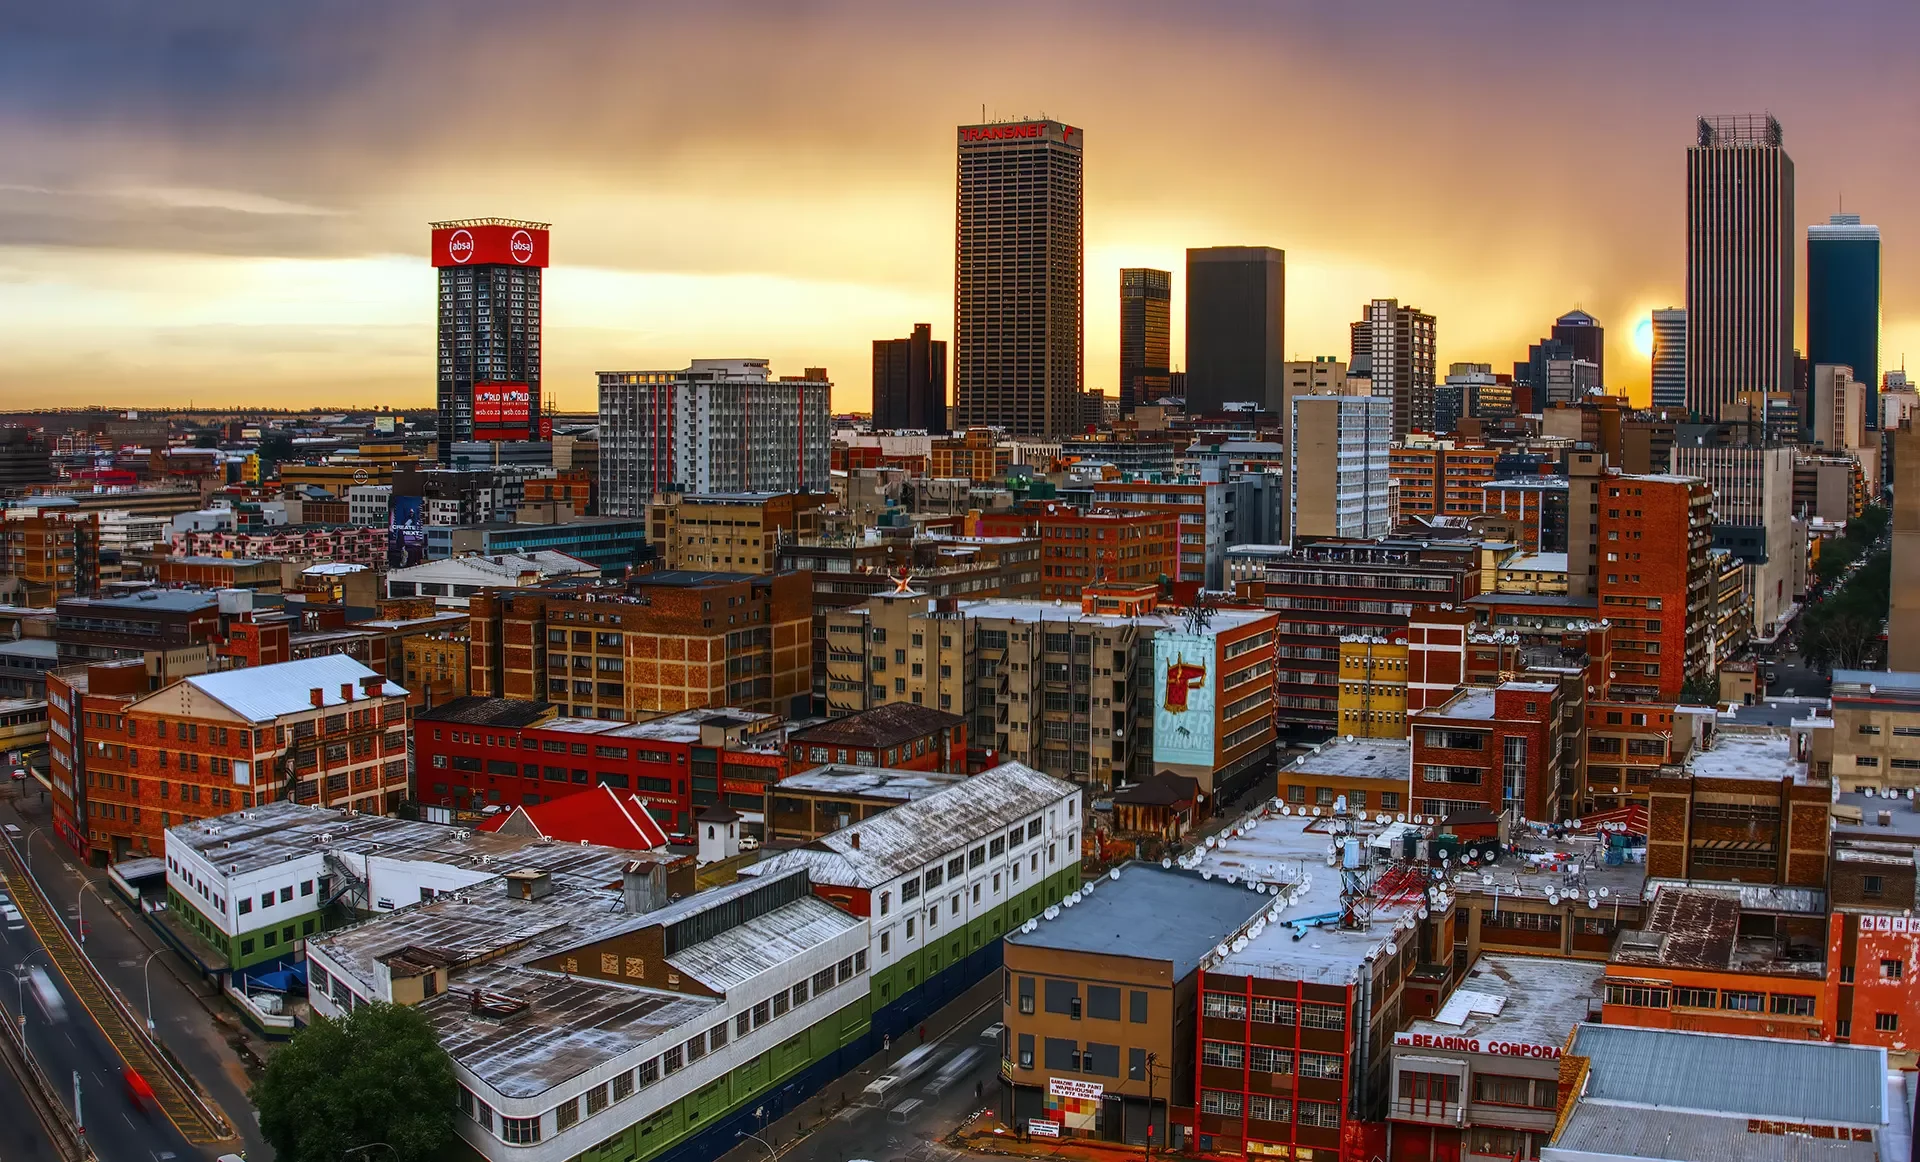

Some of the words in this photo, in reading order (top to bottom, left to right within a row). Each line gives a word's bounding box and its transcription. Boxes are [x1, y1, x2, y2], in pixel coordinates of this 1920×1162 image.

[960, 124, 1047, 142] TRANSNET
[452, 239, 470, 250] absa
[514, 239, 531, 251] absa
[1412, 1034, 1480, 1052] BEARING
[1055, 1085, 1094, 1094] WAREHOUSE
